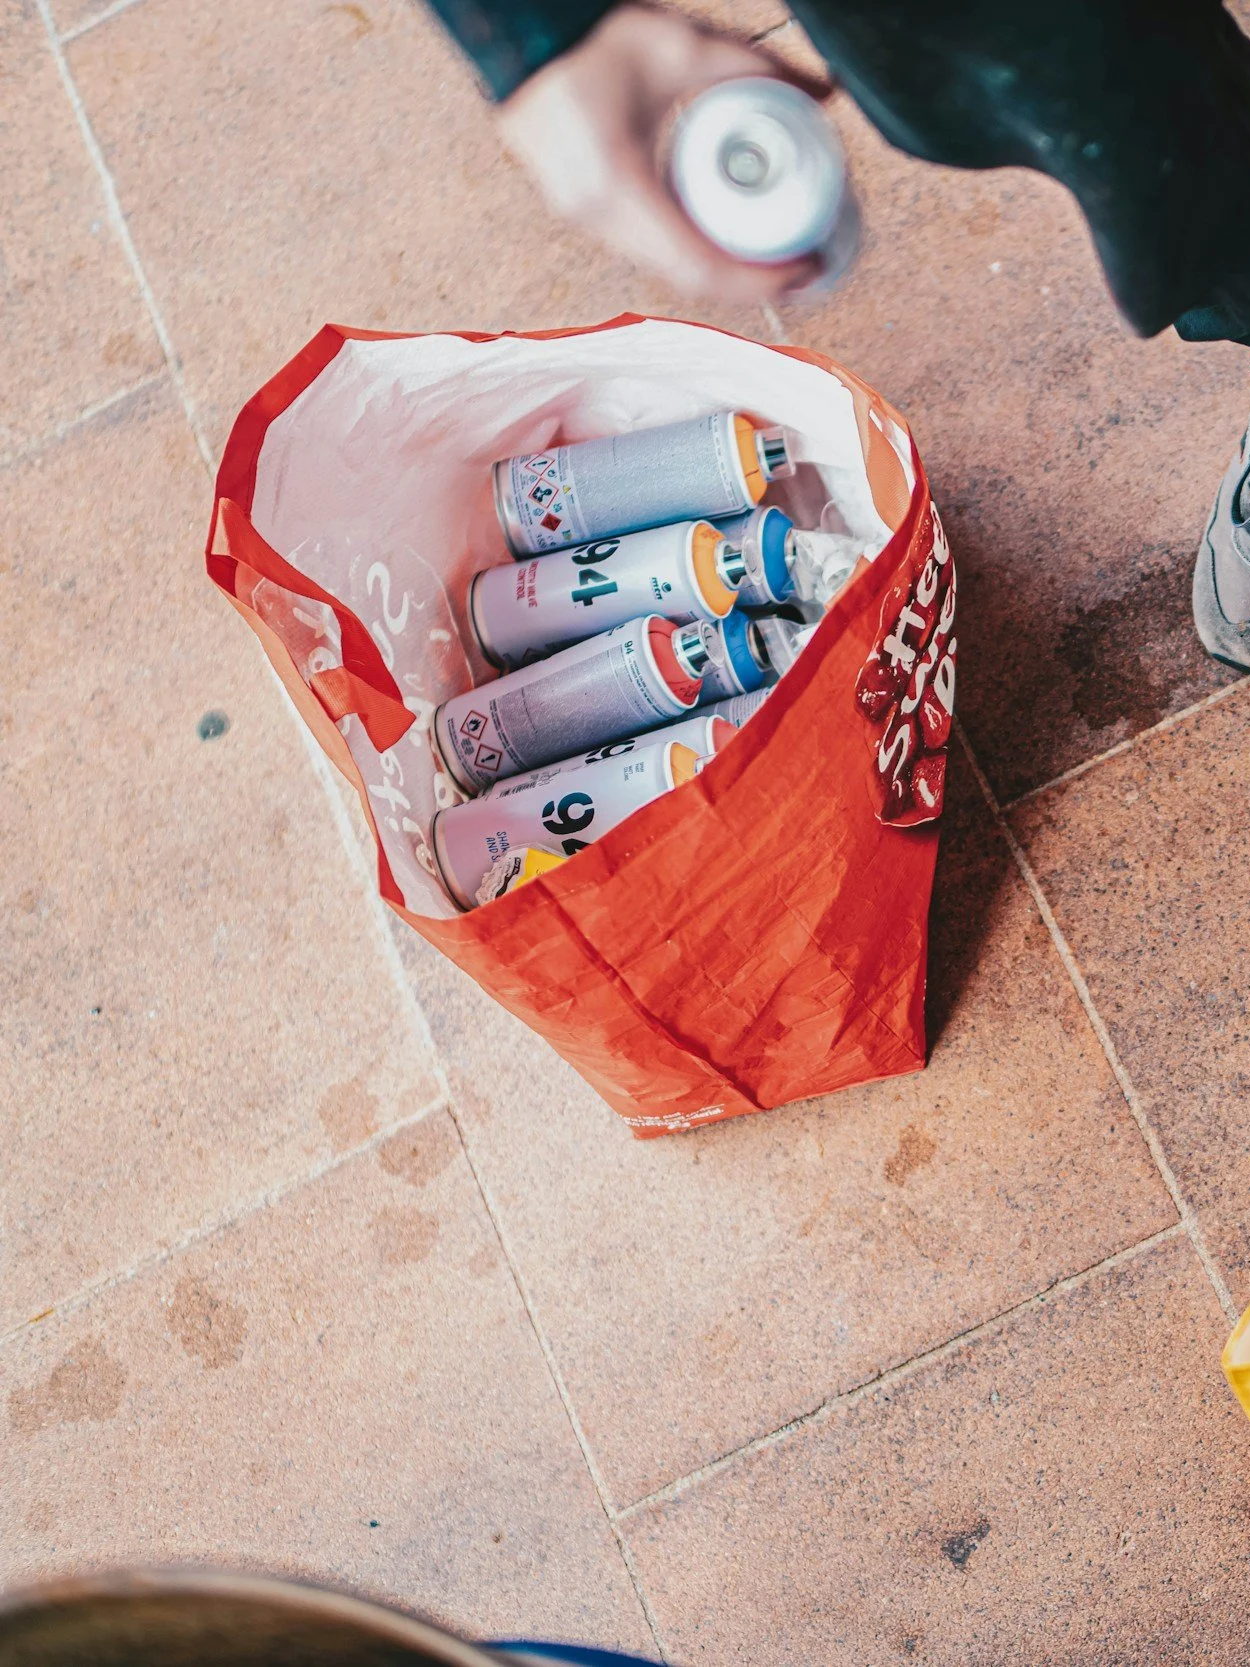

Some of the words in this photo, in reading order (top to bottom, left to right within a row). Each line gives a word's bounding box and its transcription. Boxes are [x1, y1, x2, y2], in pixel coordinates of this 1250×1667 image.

[571, 539, 620, 606] 94
[624, 640, 634, 655] 94
[485, 837, 499, 853] AND
[496, 831, 509, 853] SHAK
